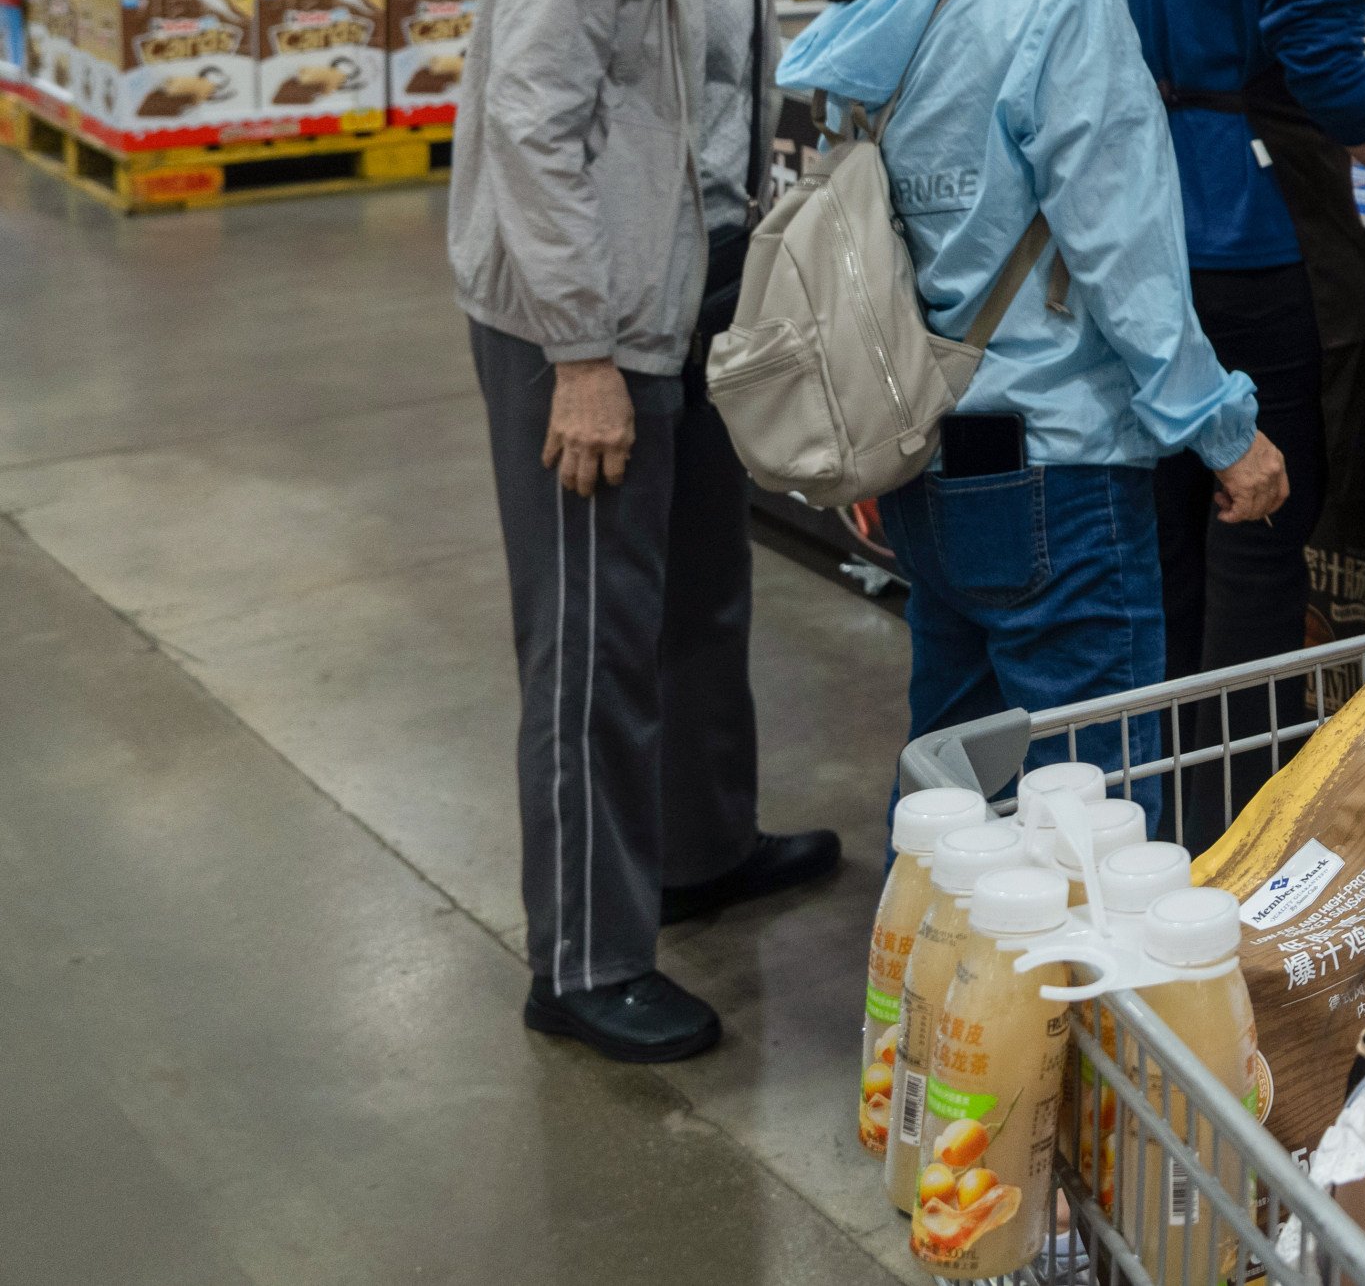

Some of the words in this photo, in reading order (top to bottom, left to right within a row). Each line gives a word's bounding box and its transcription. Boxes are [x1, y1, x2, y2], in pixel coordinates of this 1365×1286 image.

[1252, 882, 1302, 924] Member's
[1301, 857, 1330, 883] Mark
[1299, 912, 1323, 929] AND
